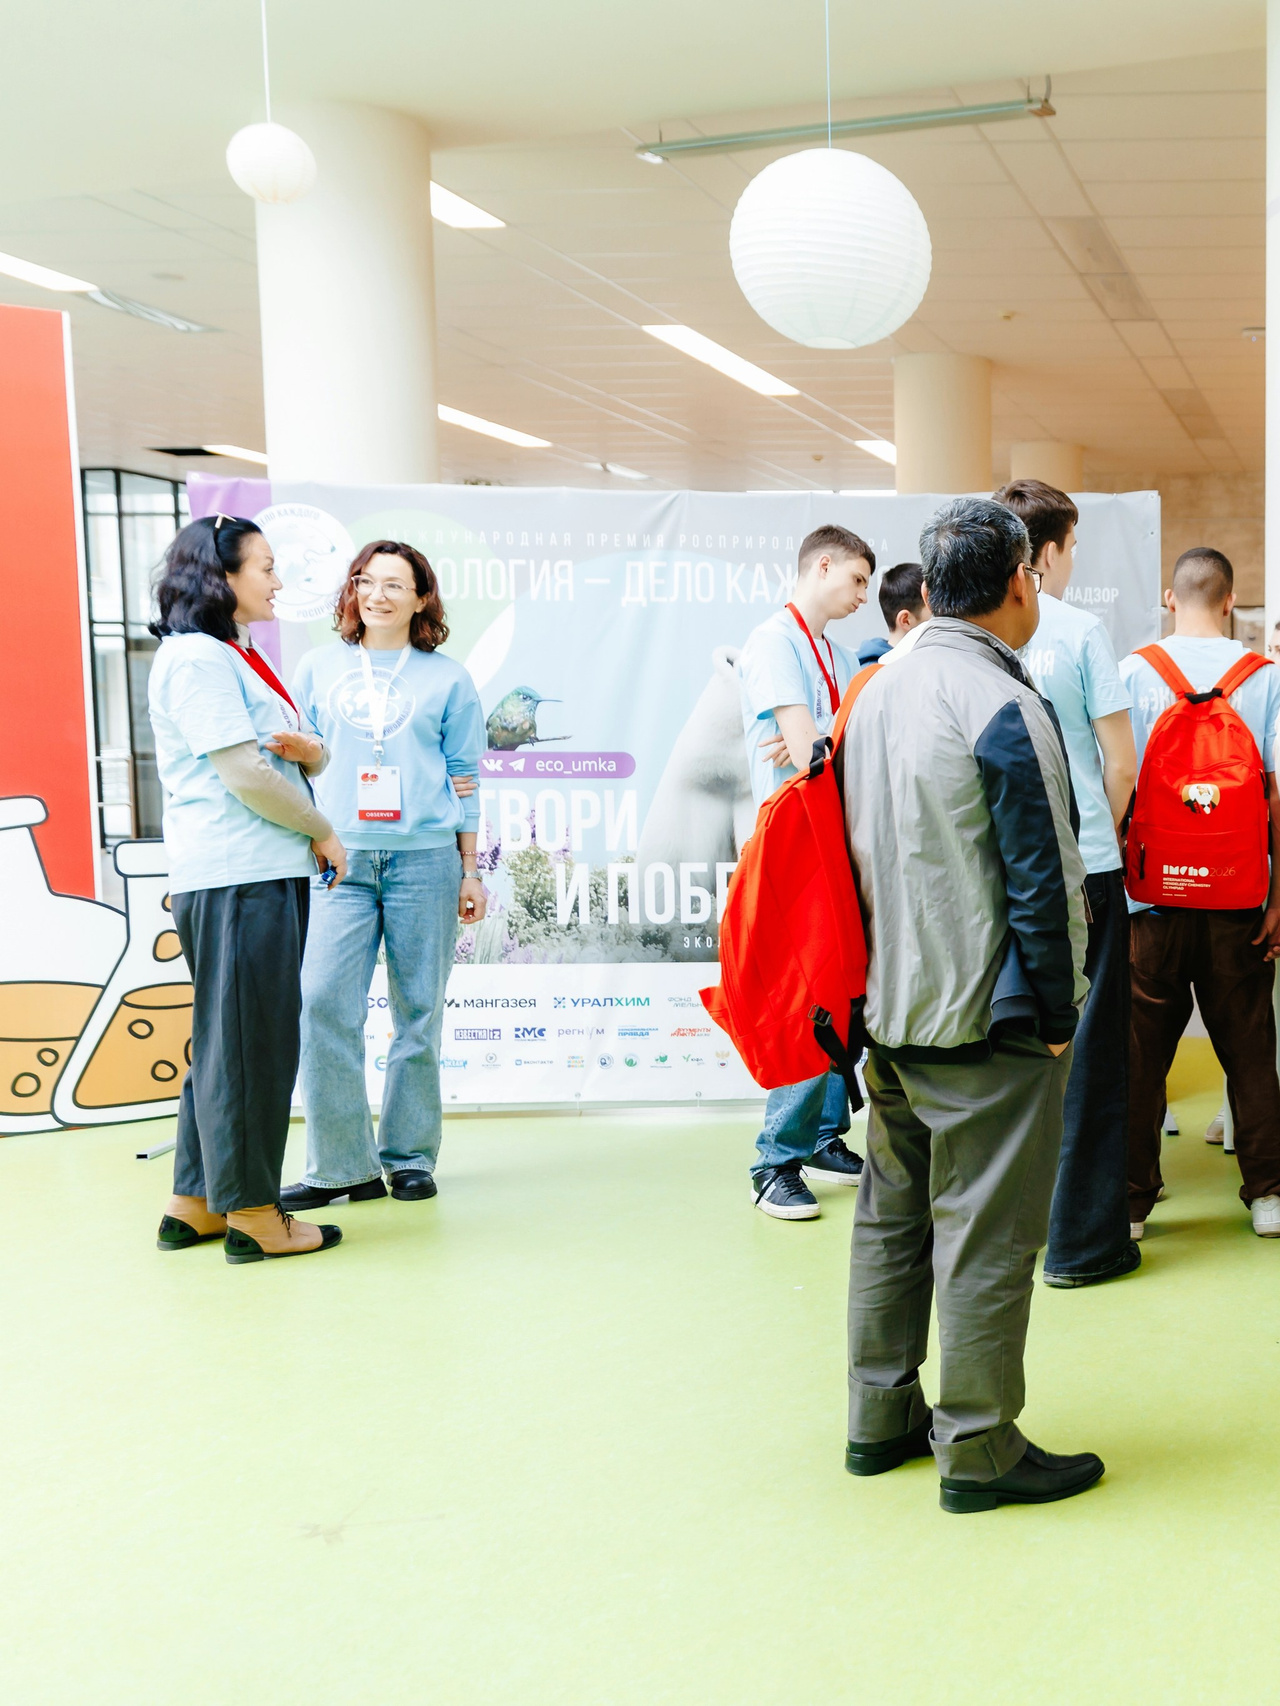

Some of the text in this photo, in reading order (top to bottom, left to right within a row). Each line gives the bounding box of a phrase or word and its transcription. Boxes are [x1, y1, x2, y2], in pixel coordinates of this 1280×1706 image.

[387, 528, 572, 548] МЕЖДУНАРОДНАЯ
[586, 532, 664, 549] ПРЕМИЯ
[434, 557, 575, 602] ОЛОГИЯ
[621, 560, 716, 607] ДЕЛО
[1063, 585, 1119, 605] НАДЗОР
[535, 757, 617, 774] eco_umka
[556, 862, 591, 924] И
[463, 998, 537, 1009] мангазея
[570, 997, 650, 1008] УРАЛХИМ
[455, 1030, 487, 1040] ИЗВЕСТИЯ
